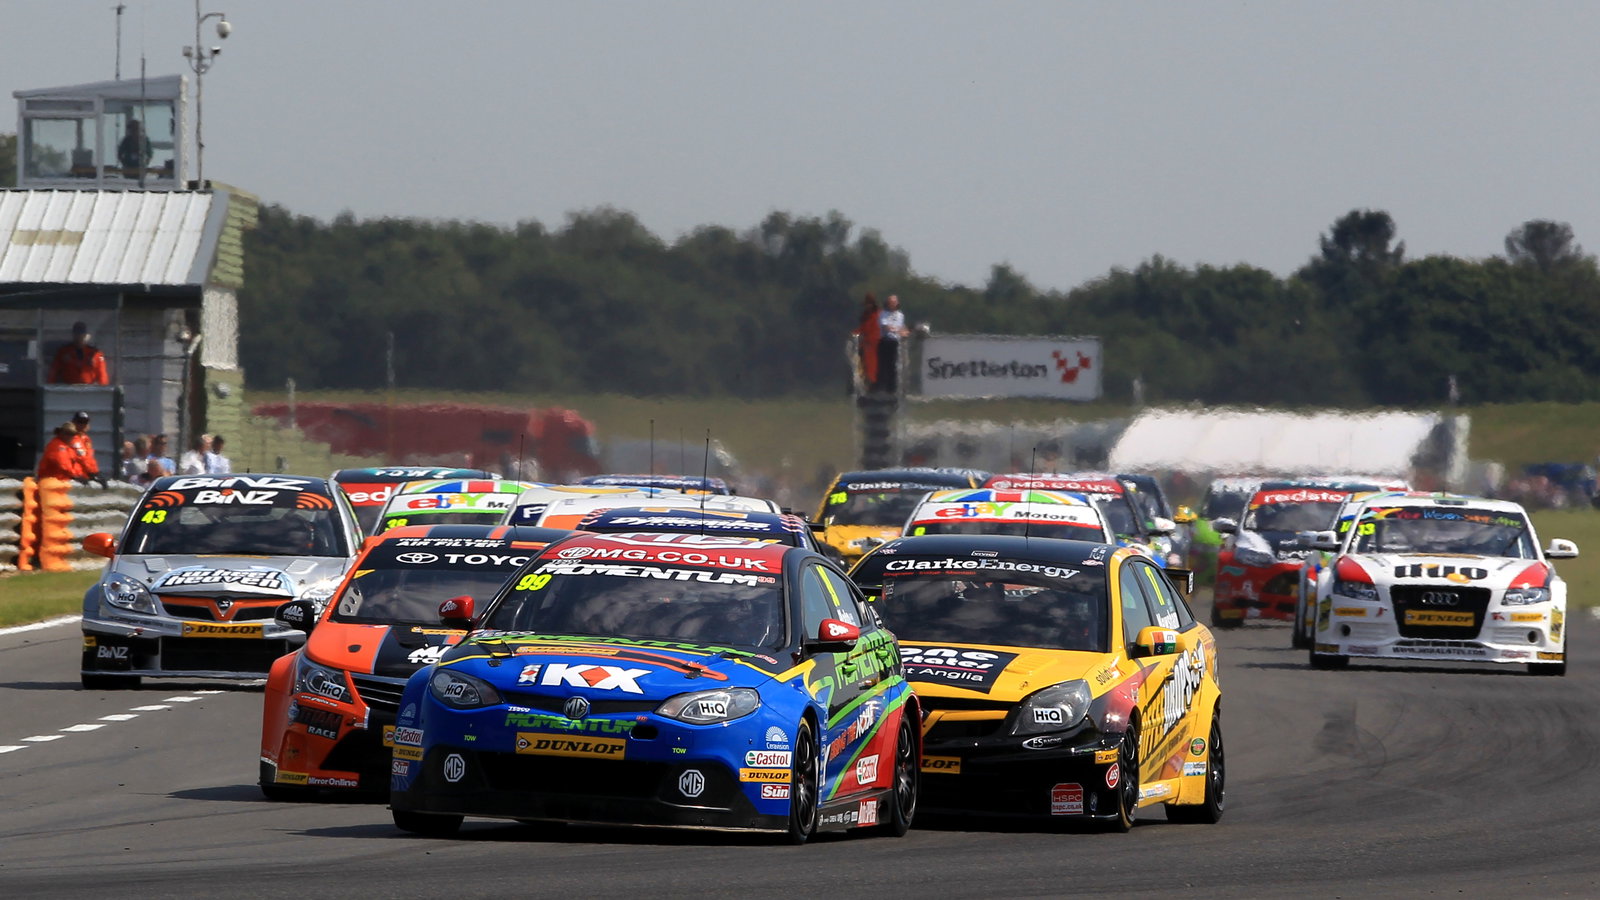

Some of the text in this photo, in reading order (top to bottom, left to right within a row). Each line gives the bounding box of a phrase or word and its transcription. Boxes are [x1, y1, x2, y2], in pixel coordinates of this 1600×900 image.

[927, 357, 1047, 379] Snetterton
[141, 510, 167, 524] 43
[1014, 511, 1078, 521] Motors
[592, 549, 769, 571] MG.CO.UK
[180, 570, 281, 579] wheel
[533, 561, 760, 587] MOMENTUM
[515, 574, 553, 591] 99
[1416, 615, 1473, 623] DUNLOP
[196, 625, 262, 634] DUNLOP
[541, 663, 653, 695] KX
[918, 668, 984, 682] Anglia
[319, 683, 344, 698] HiQ
[445, 685, 463, 696] HiQ
[701, 702, 726, 715] HiQ
[505, 713, 638, 733] MOMENTUM
[1035, 709, 1061, 723] HiQ
[308, 726, 337, 739] RACE
[464, 734, 477, 742] TOW
[535, 740, 624, 755] DUNLOP
[757, 752, 789, 766] Castrol
[446, 756, 463, 780] MG
[748, 772, 789, 780] DUNLOP
[681, 772, 703, 795] MG
[1053, 794, 1081, 803] HSPC
